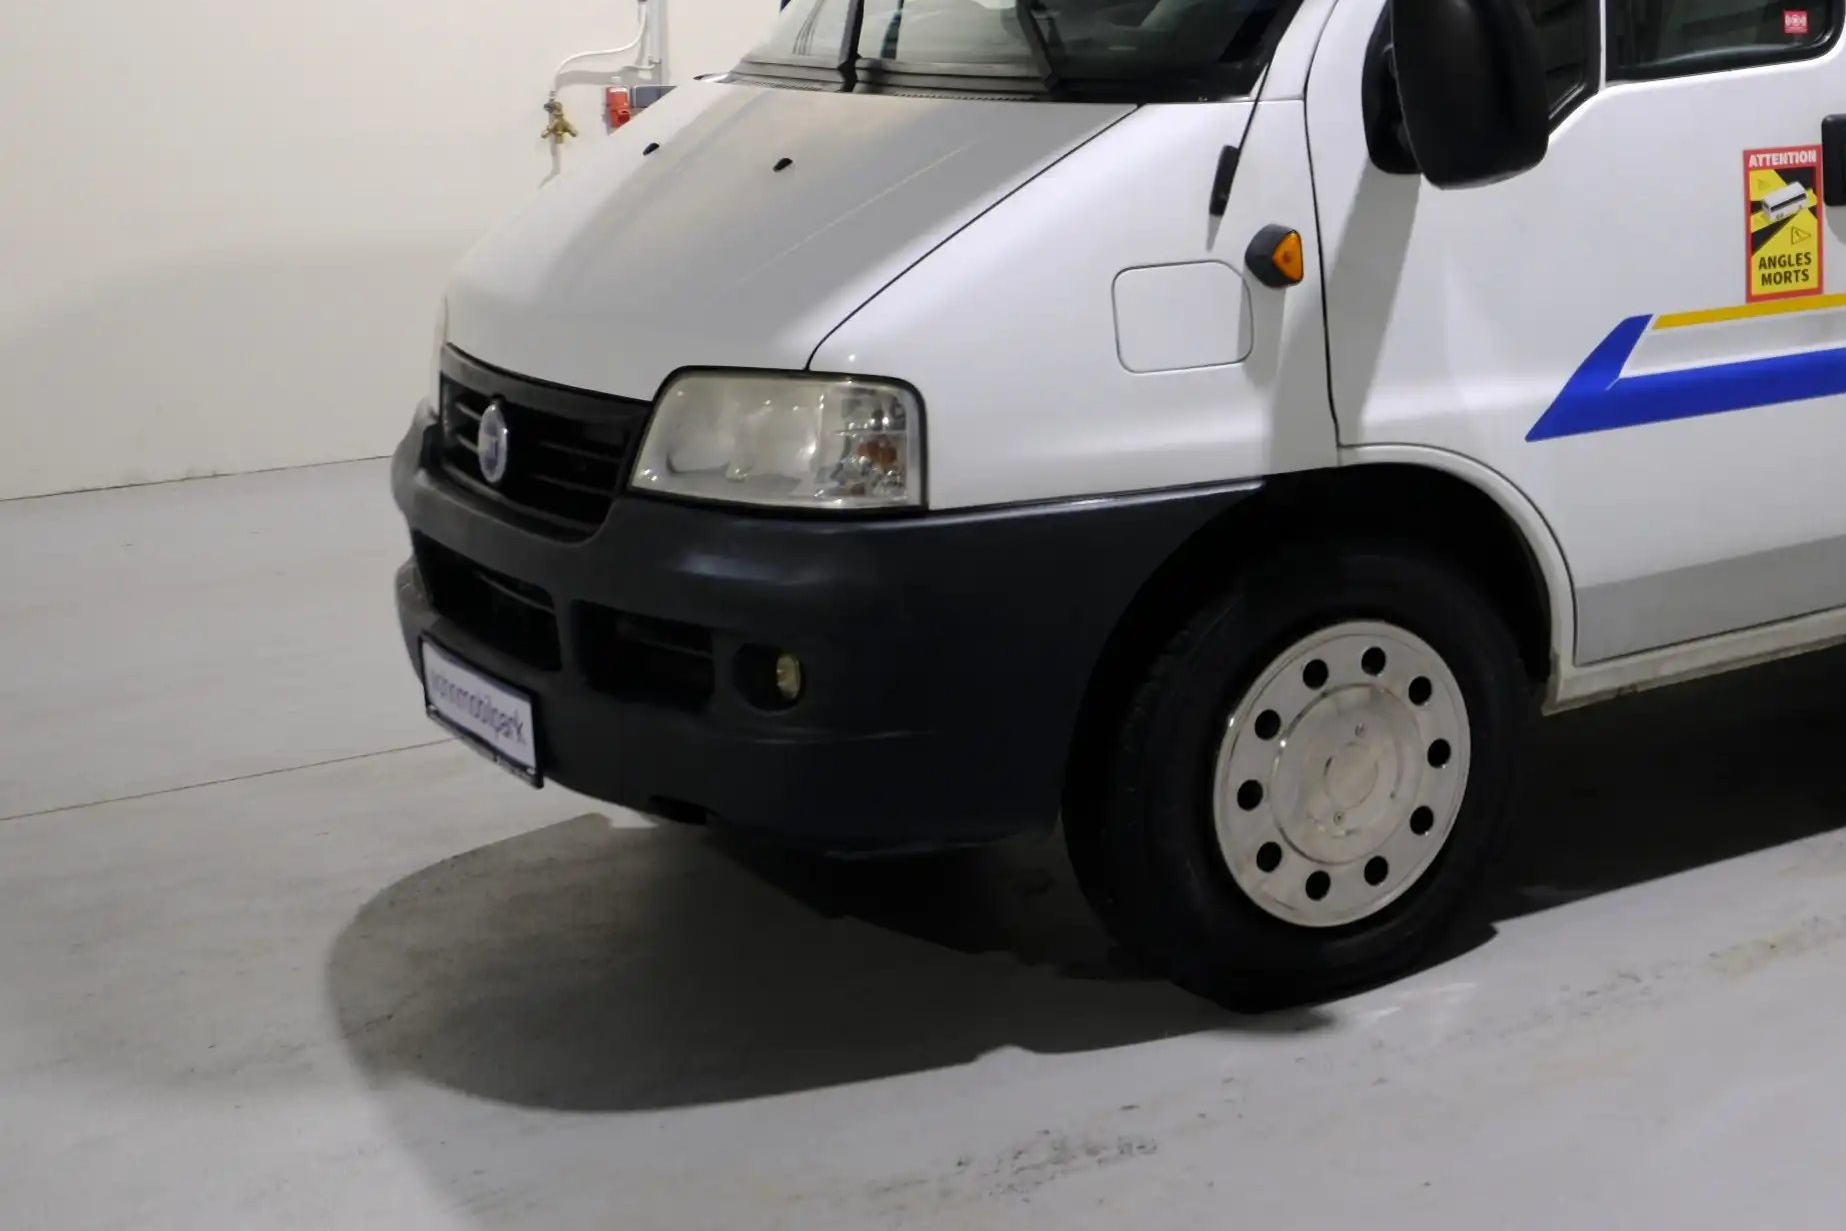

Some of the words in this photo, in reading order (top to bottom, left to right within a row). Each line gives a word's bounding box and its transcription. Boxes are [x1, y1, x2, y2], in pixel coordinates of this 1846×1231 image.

[1748, 150, 1817, 168] ATTENTION
[1758, 251, 1812, 270] ANGLES
[1761, 269, 1810, 286] MORTS
